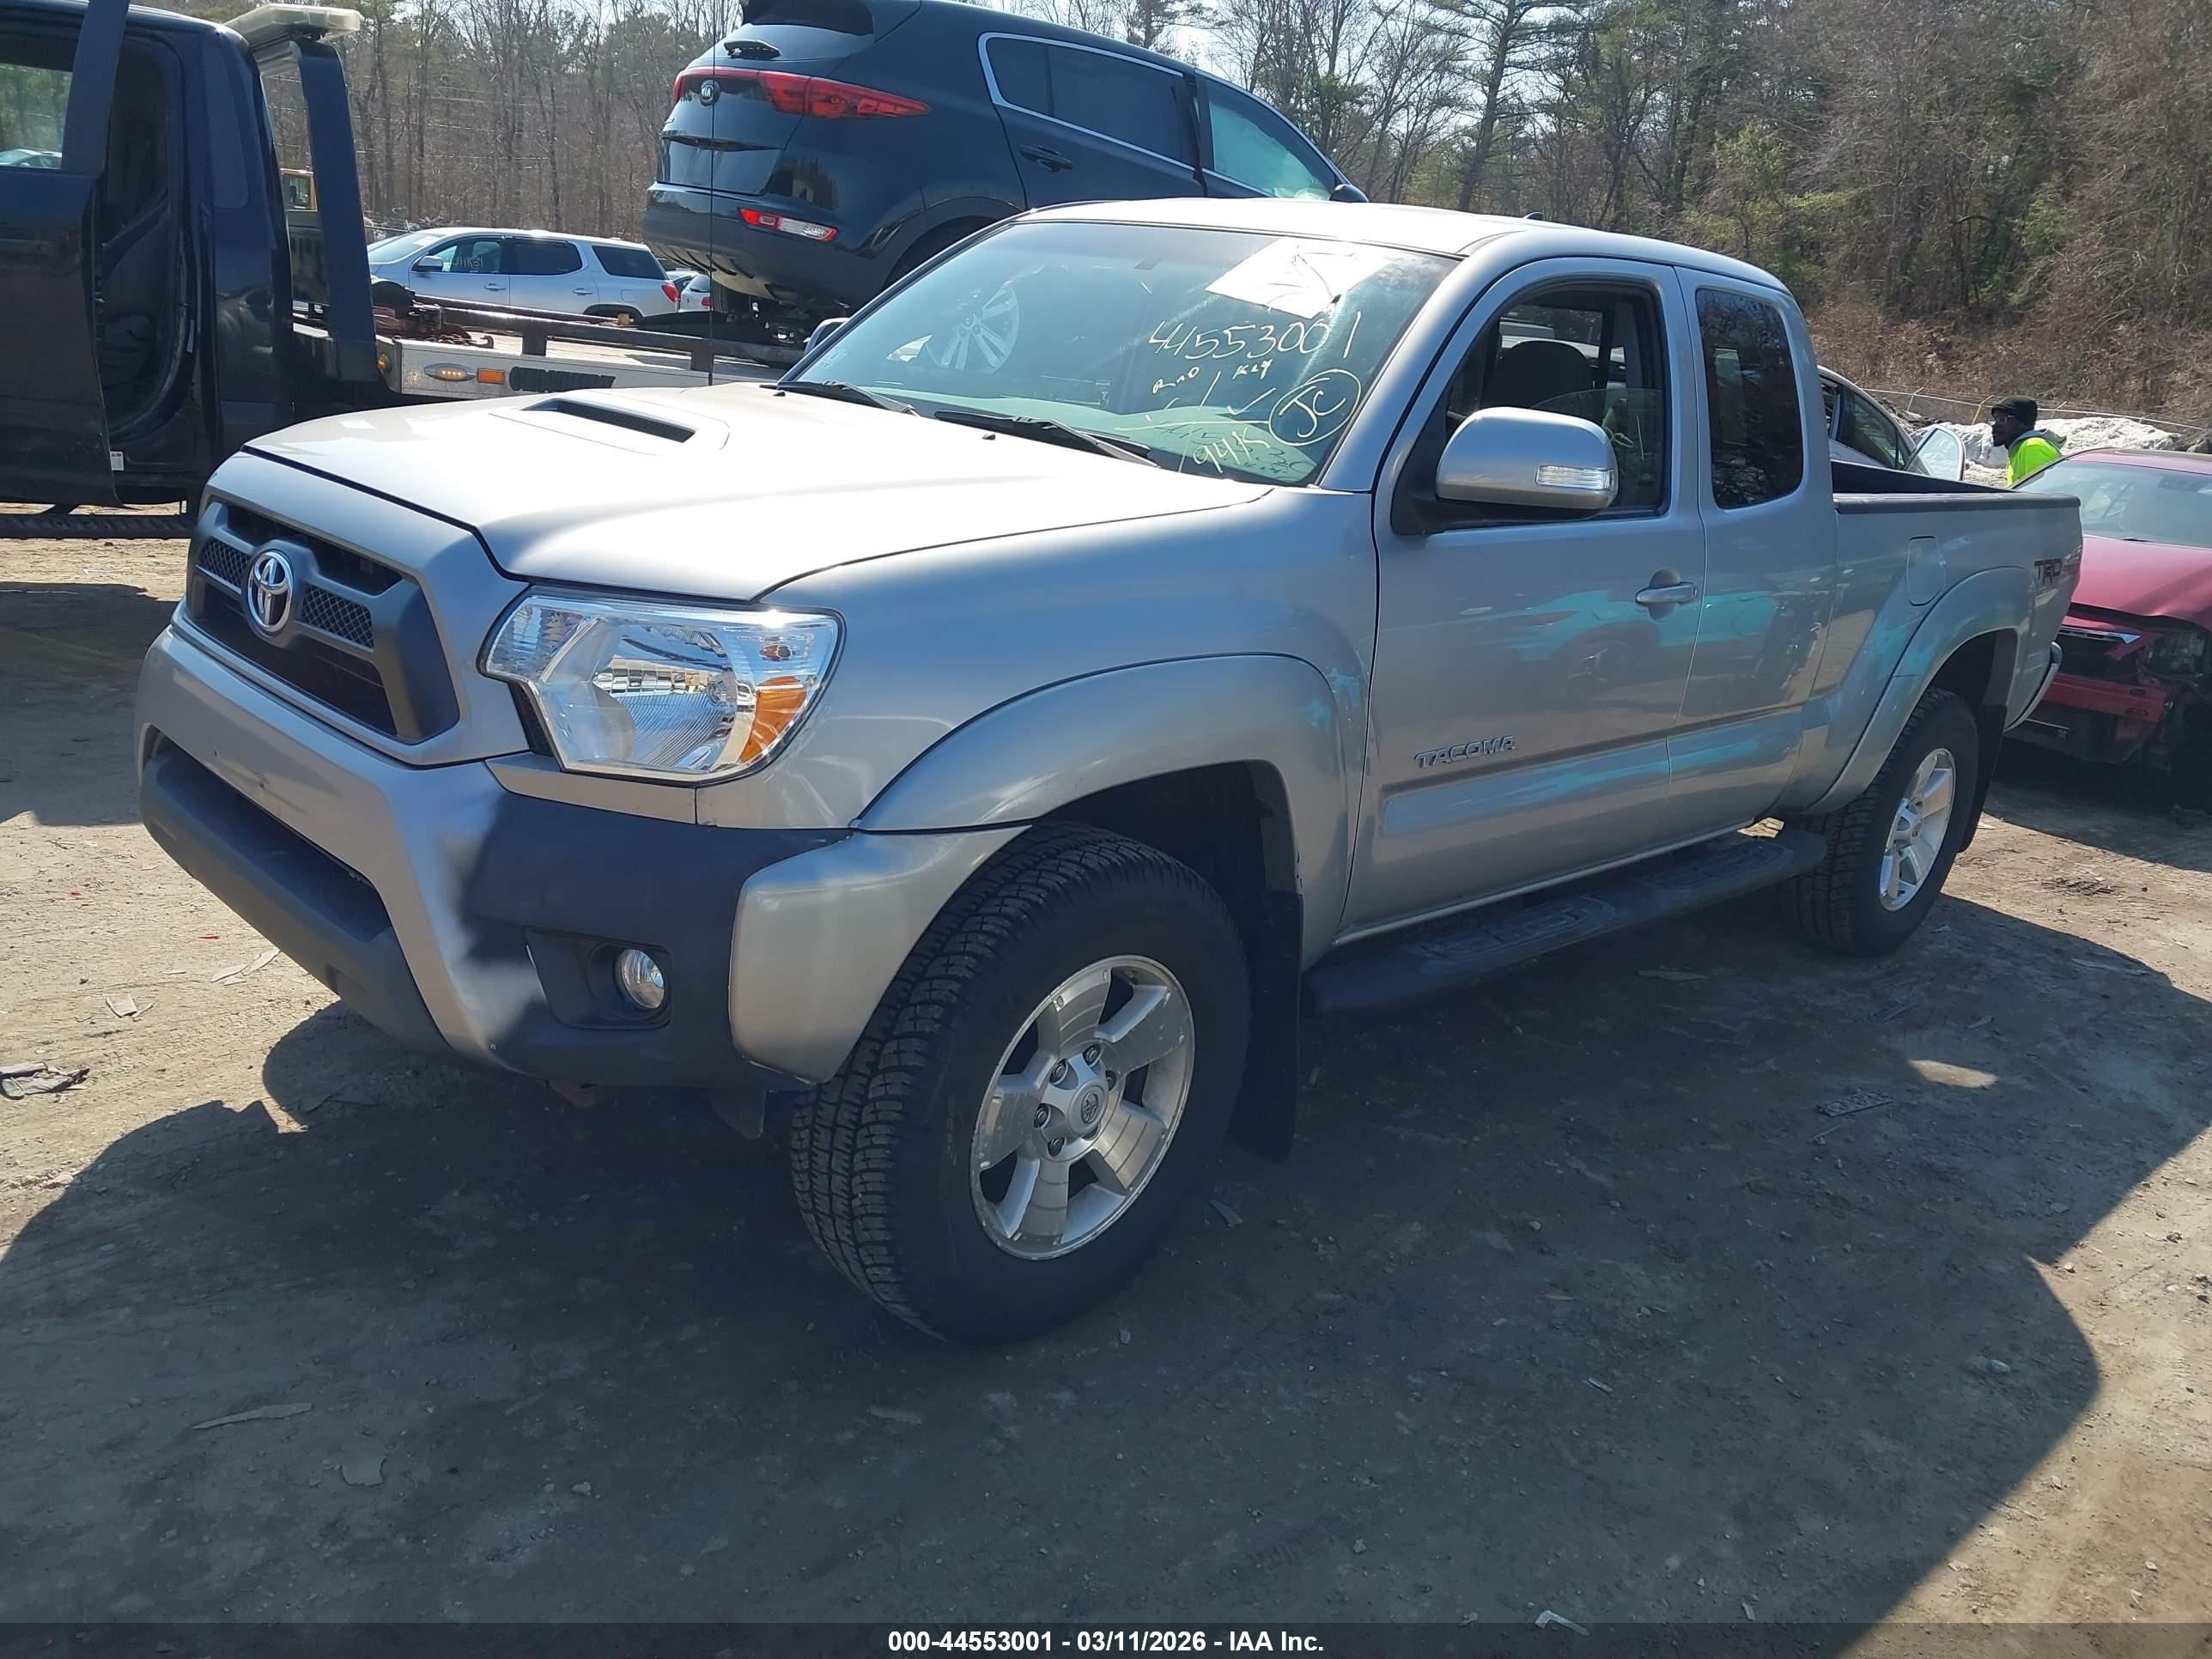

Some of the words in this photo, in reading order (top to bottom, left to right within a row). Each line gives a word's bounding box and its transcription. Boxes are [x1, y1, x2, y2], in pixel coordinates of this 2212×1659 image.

[1148, 311, 1362, 360] 44553001
[1193, 427, 1271, 474] 94K
[2033, 557, 2062, 585] TRD
[1413, 735, 1517, 769] TACOMA
